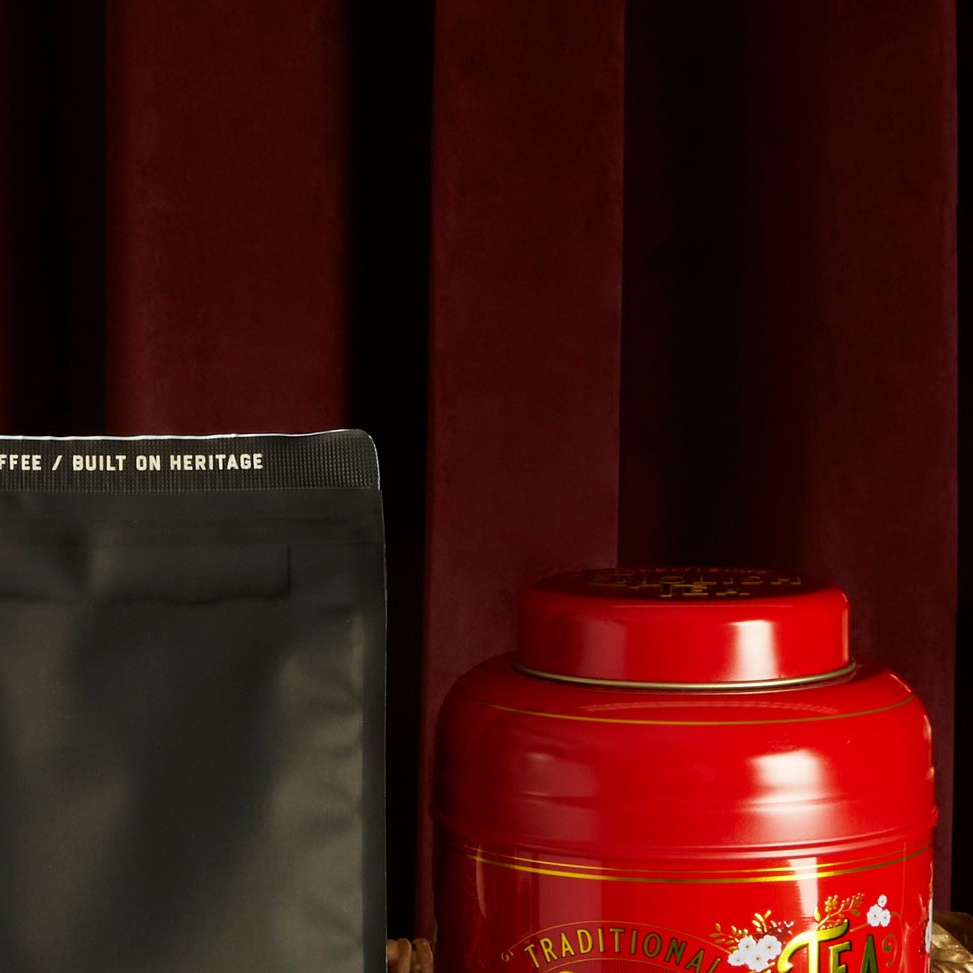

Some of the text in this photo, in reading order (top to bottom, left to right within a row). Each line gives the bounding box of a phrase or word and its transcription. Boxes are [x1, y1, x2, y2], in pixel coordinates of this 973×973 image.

[52, 455, 62, 470] /
[72, 454, 126, 471] BUILT
[136, 454, 162, 471] ON
[170, 453, 263, 470] HERITAGE
